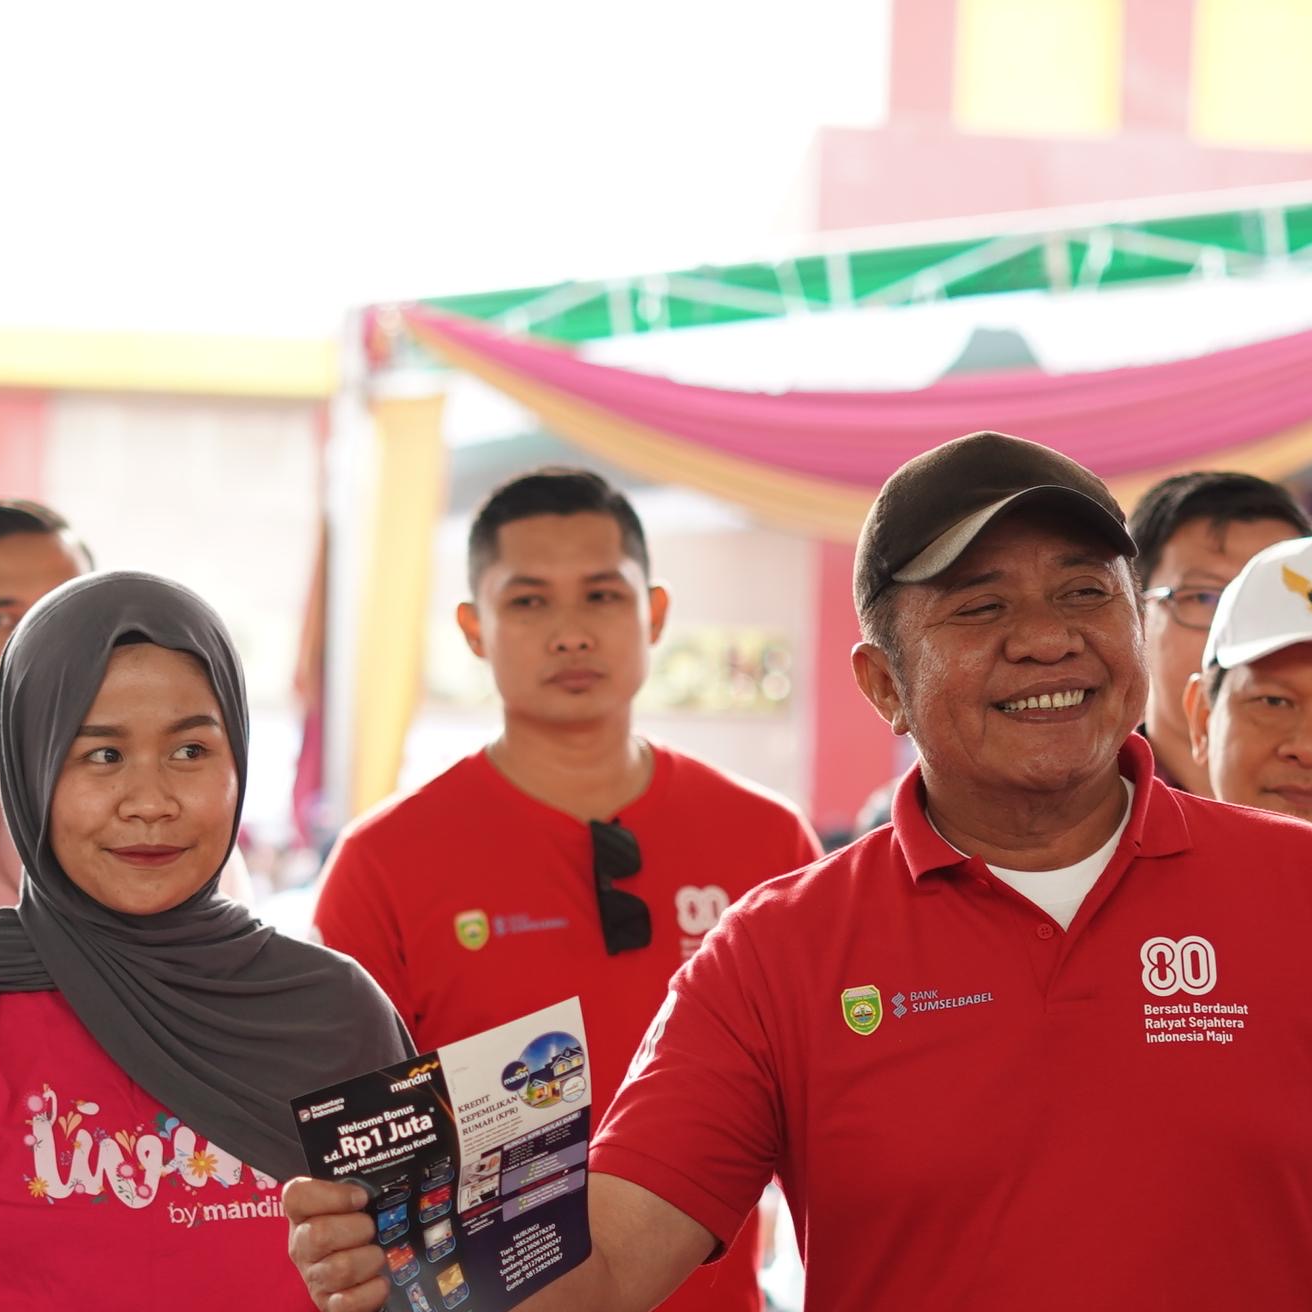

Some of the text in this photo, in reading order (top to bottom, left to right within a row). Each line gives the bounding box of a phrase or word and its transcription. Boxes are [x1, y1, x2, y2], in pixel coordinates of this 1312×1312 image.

[1140, 935, 1217, 997] 80
[910, 989, 938, 1001] BANK
[912, 992, 994, 1013] SUMSELBABEL
[1144, 1002, 1248, 1015] Bersatu Berdaulat
[1145, 1016, 1244, 1031] Rakyat Sejahtera
[1146, 1030, 1233, 1045] Indonesia Maju
[458, 1093, 491, 1113] KREDIT
[460, 1095, 519, 1124] KEPEMILIKAN
[338, 1105, 415, 1136] Welcome Bonus
[462, 1117, 494, 1136] RUMAH
[495, 1106, 519, 1121] (KPR)
[323, 1150, 342, 1164] s.d.
[340, 1128, 383, 1157] Rp1
[333, 1161, 358, 1175] Apply
[358, 1149, 390, 1167] Mandiri
[390, 1142, 413, 1158] Kartu
[413, 1133, 437, 1149] Kredit
[168, 1201, 197, 1228] by
